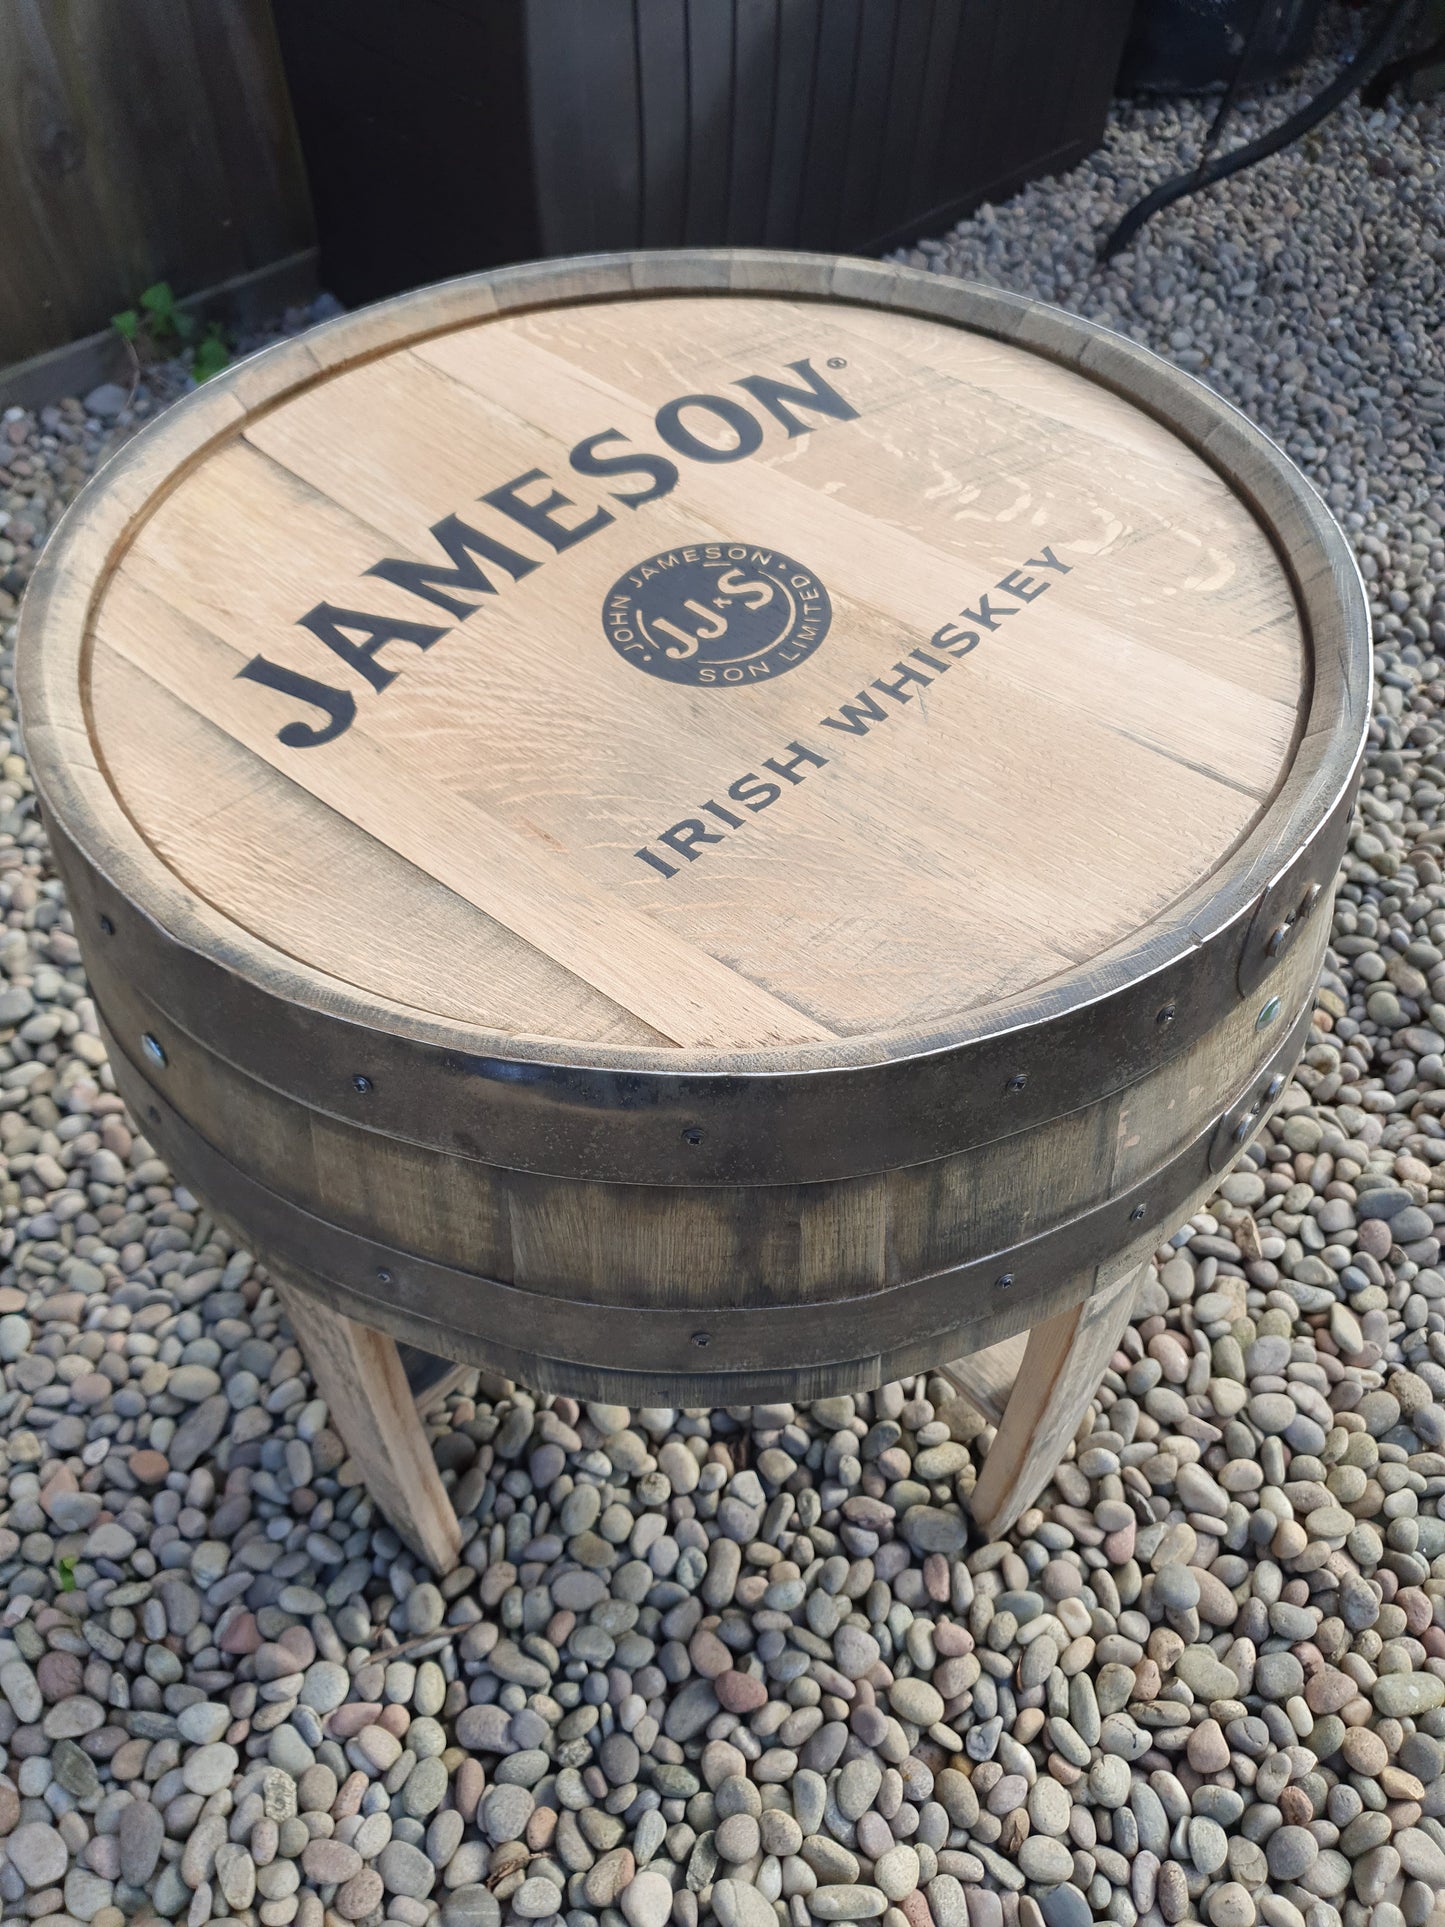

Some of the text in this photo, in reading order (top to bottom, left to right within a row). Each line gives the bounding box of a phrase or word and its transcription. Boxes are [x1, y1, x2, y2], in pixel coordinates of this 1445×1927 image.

[233, 357, 861, 748] JAMESON
[609, 546, 822, 683] JOHN JAMESON SON LIMITED
[633, 546, 1074, 879] IRISH WHISKEY
